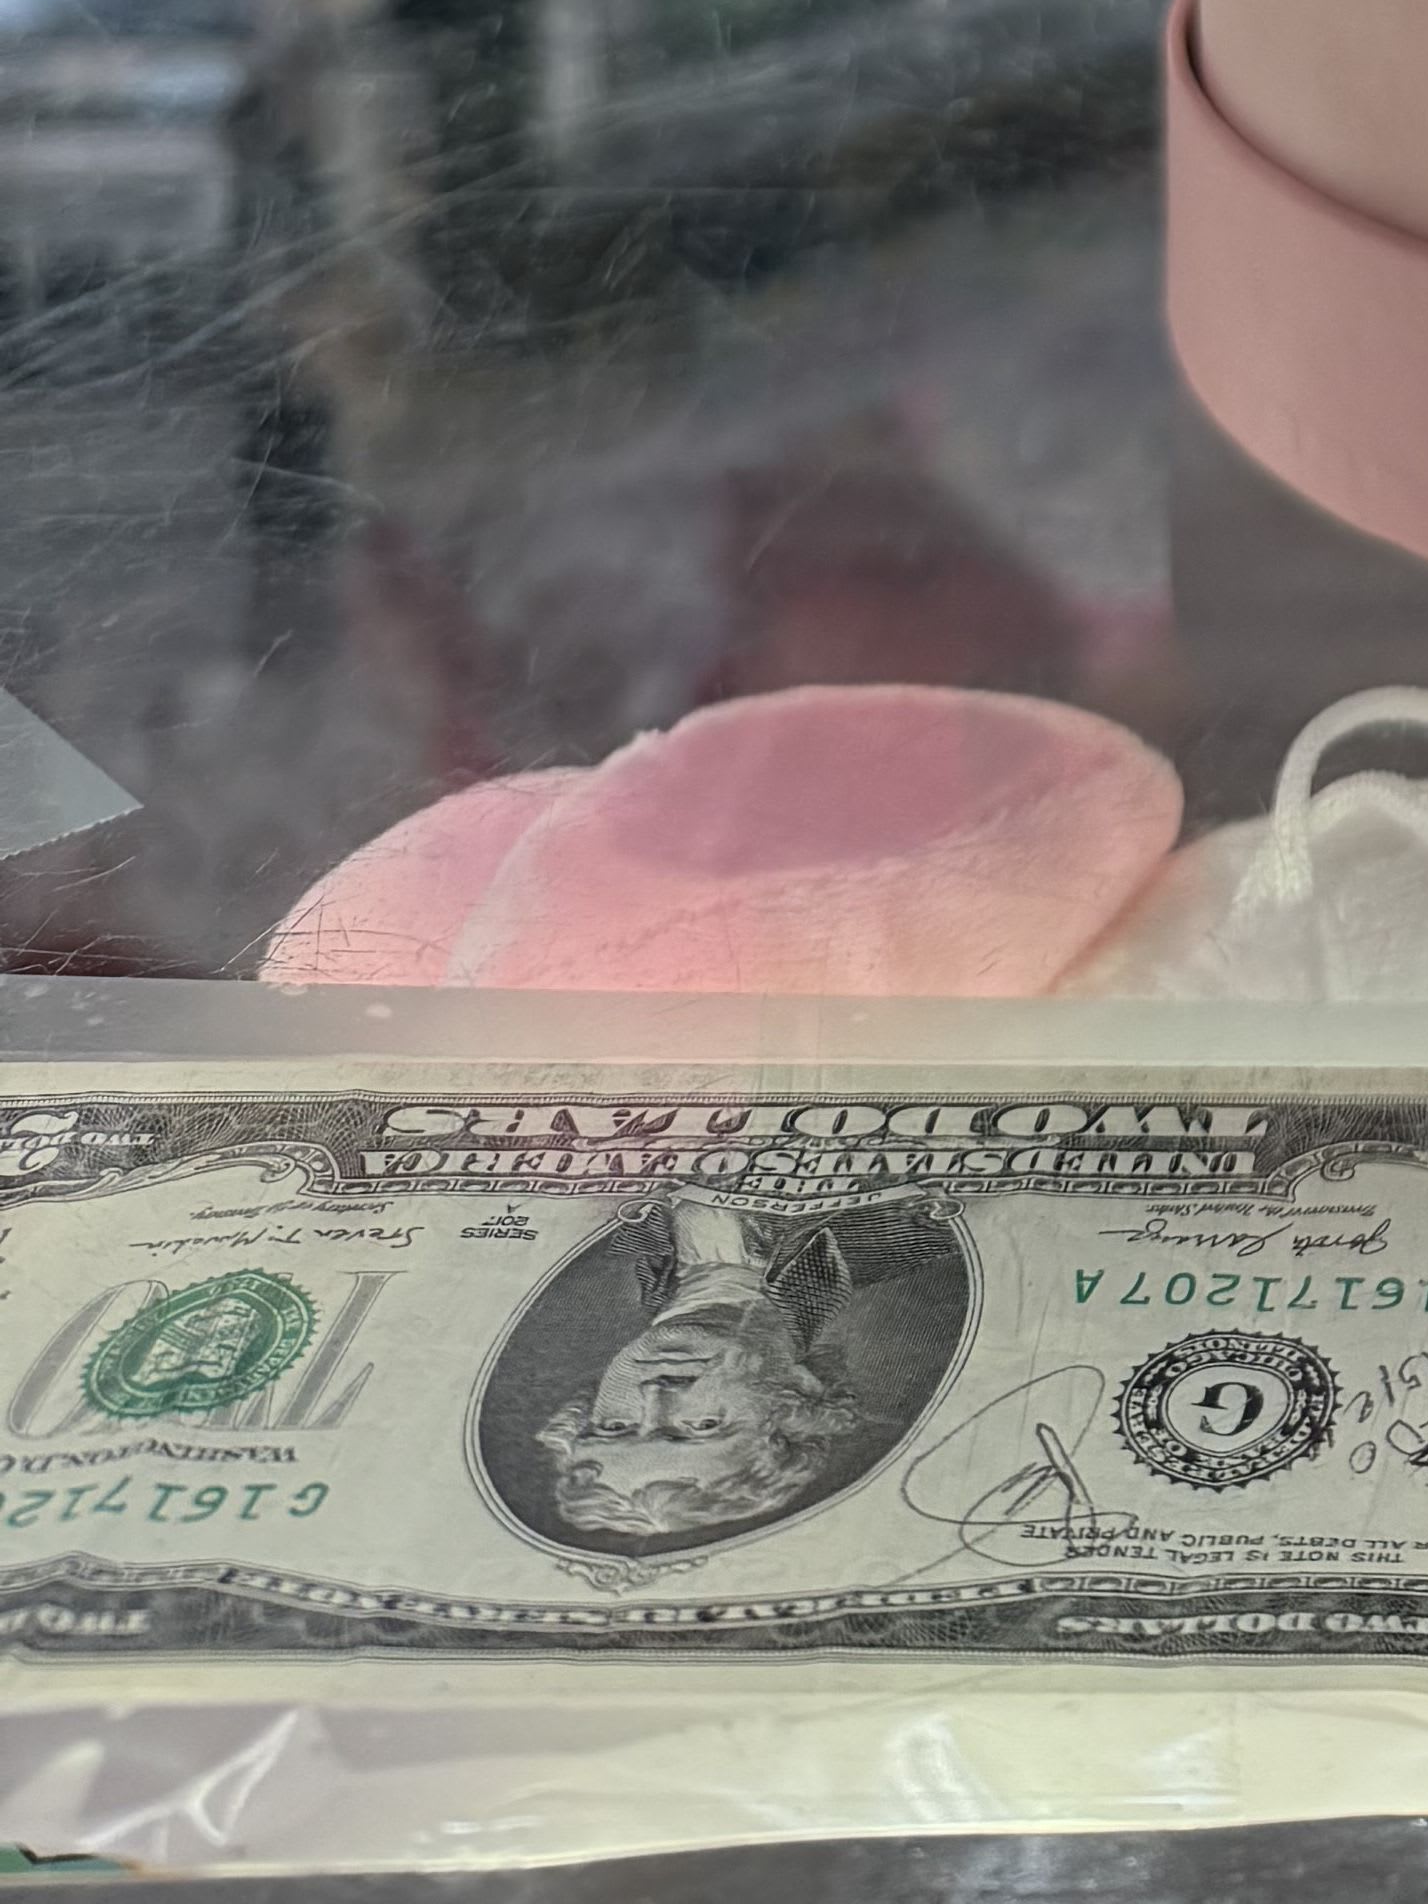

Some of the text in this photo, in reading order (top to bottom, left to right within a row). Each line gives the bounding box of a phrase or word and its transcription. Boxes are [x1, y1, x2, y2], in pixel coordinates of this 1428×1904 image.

[380, 1103, 1268, 1138] TWO DOLLARS
[359, 1146, 1254, 1176] UNITED STATES OF AMERICA
[711, 1191, 883, 1215] JEFFERSON
[313, 1225, 425, 1249] Steven
[459, 1226, 540, 1242] SERIES
[1164, 1352, 1302, 1383] CHICAGO
[1190, 1381, 1264, 1438] G
[1019, 1525, 1116, 1541] PRIVATE
[1126, 1526, 1175, 1542] AND
[1180, 1533, 1265, 1546] PUBLIC
[1271, 1534, 1357, 1547] DEBTS,
[1064, 1545, 1404, 1565] THIS NOTE IS LEGAL TENDER
[1361, 1539, 1408, 1550] ALL
[1054, 1612, 1318, 1635] DOLLARS
